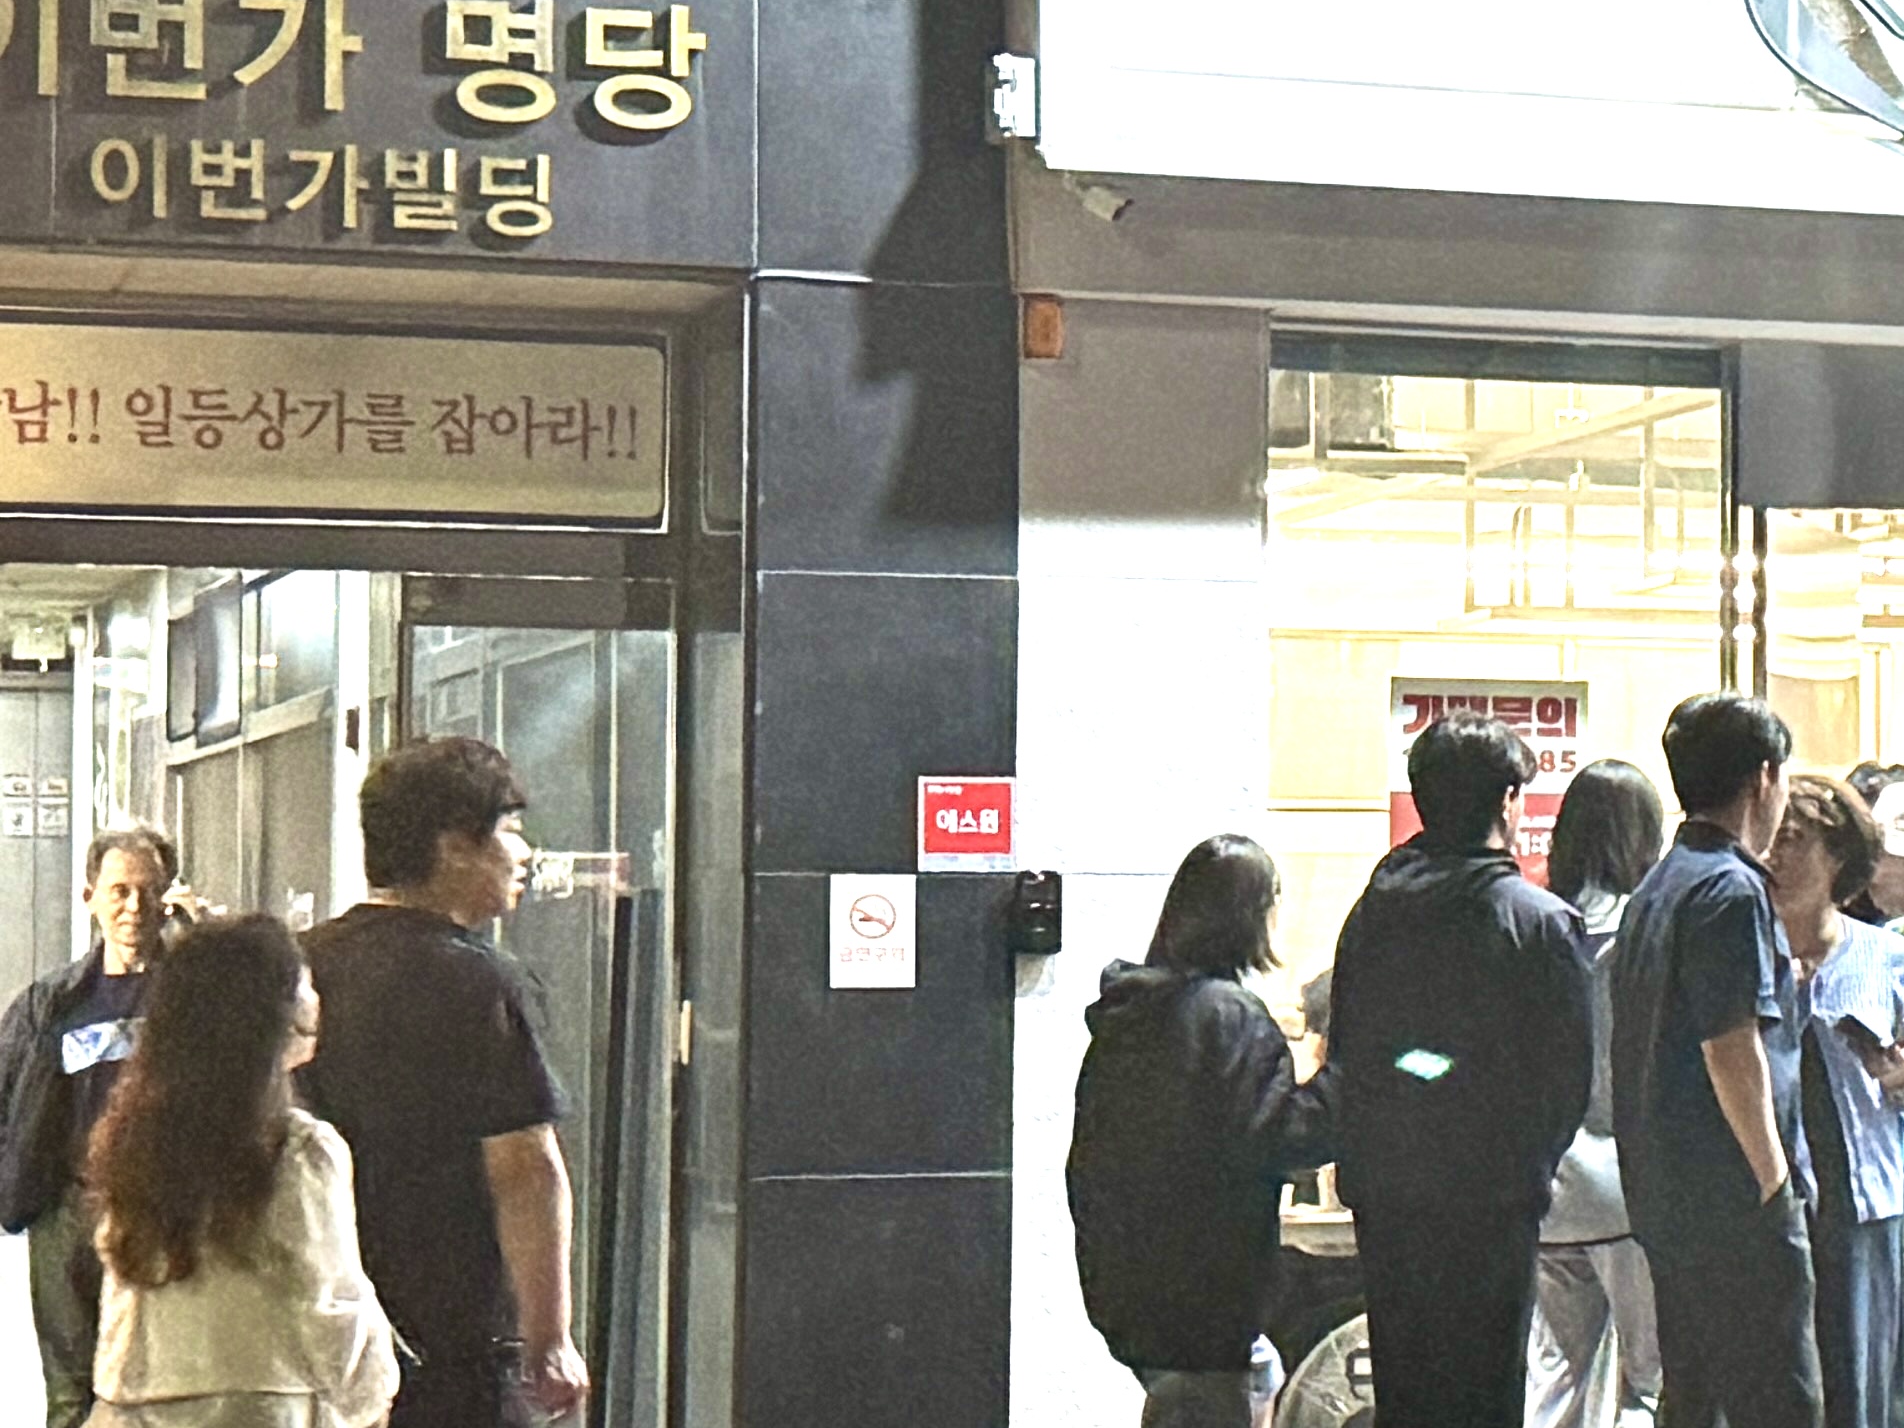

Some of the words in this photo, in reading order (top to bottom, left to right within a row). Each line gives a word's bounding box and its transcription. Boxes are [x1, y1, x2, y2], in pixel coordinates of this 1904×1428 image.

[90, 136, 552, 238] 이번가빌딩
[0, 378, 102, 445] 남!!
[125, 384, 415, 456] 일등상가를
[431, 394, 639, 461] 잡아라!!
